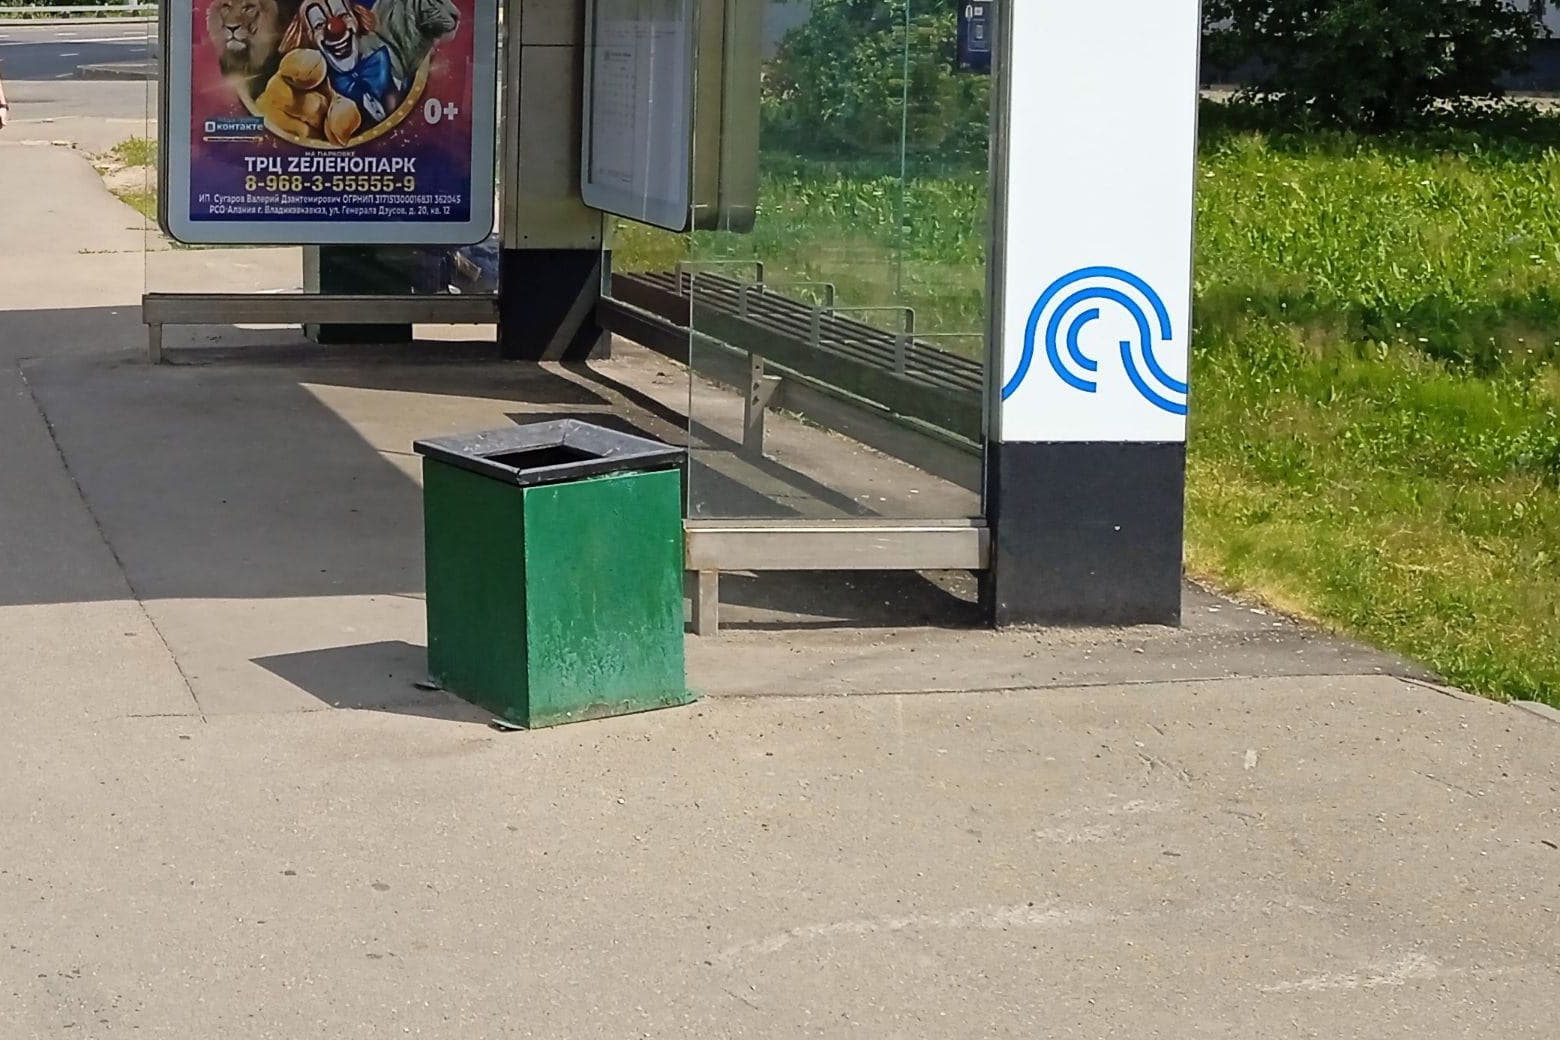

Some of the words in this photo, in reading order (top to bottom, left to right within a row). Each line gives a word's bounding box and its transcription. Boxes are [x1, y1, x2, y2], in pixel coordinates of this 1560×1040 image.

[423, 97, 459, 125] 0+
[244, 156, 282, 174] ТРЦ
[287, 157, 417, 173] ZЕЛЕНОПАРК
[245, 175, 415, 192] 8-968-3-55555-9
[246, 193, 279, 204] Валерий
[342, 194, 374, 204] ОГРНИП
[434, 194, 461, 204] 362045
[342, 205, 377, 216] Генерала
[442, 206, 450, 215] 12
